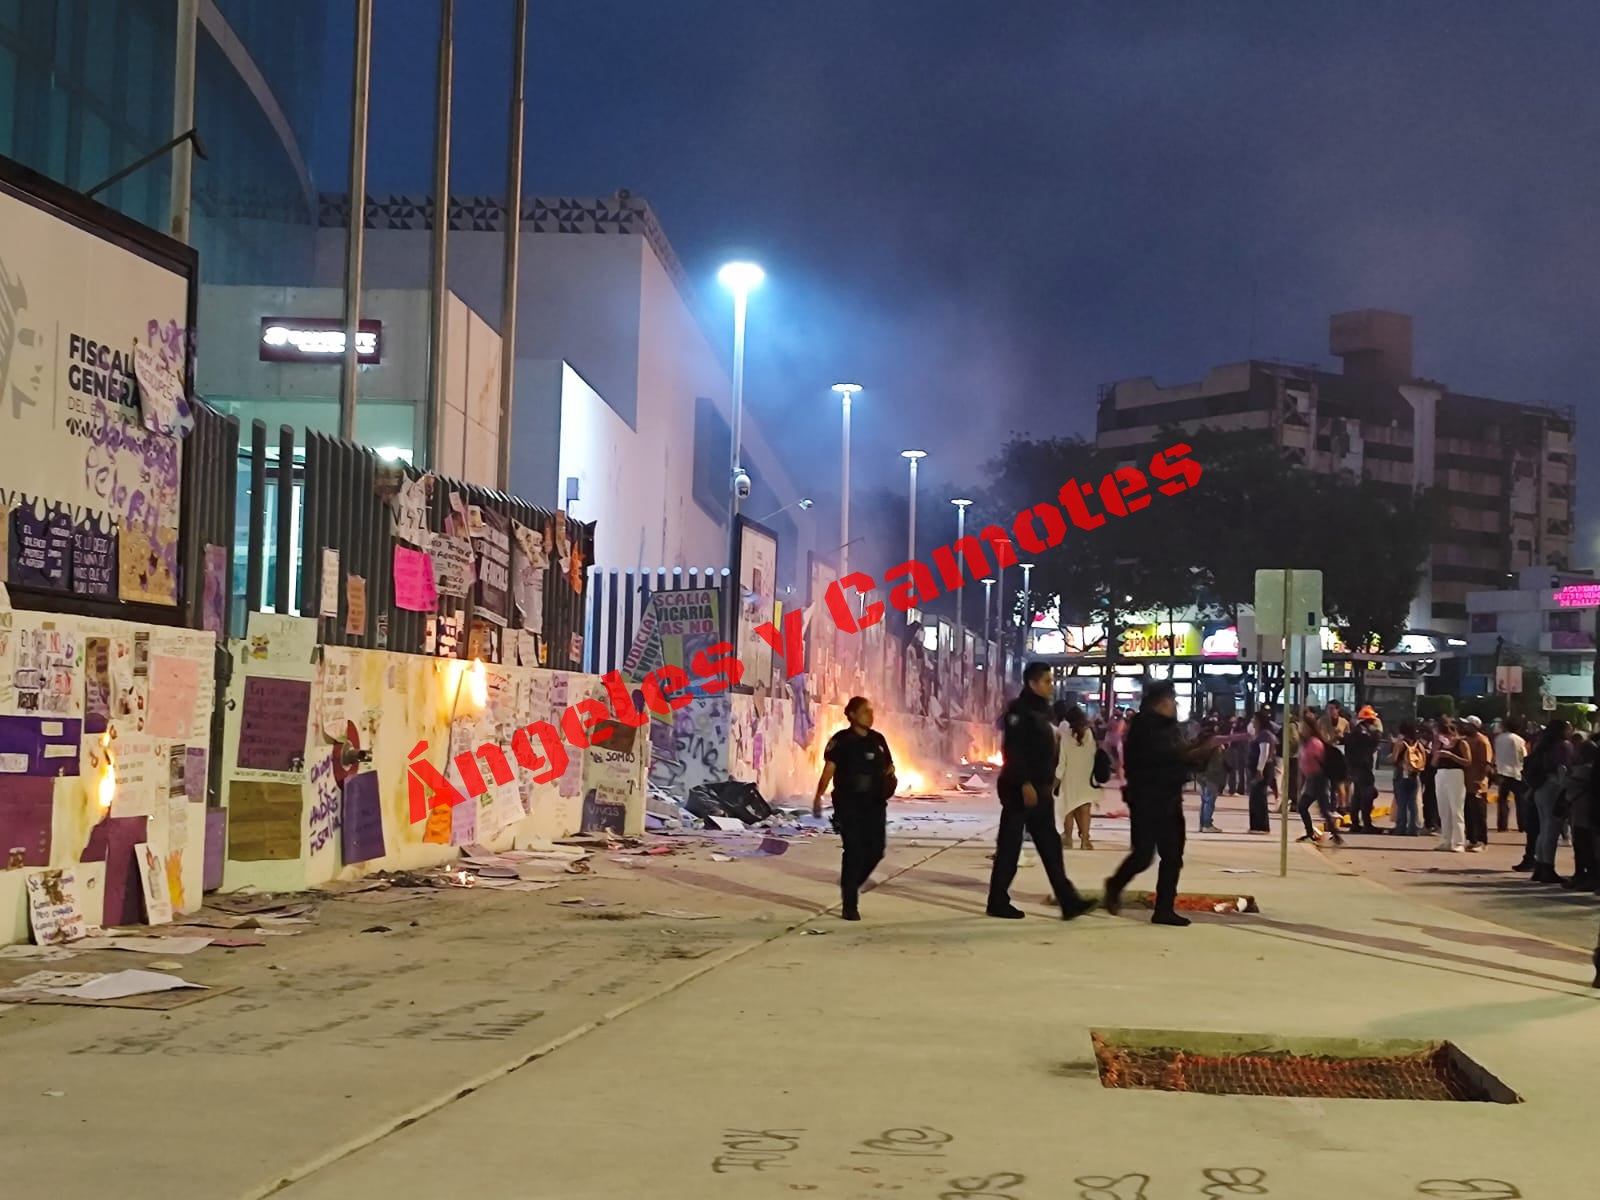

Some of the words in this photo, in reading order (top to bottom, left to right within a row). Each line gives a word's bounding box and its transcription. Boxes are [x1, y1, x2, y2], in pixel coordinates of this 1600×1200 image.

[68, 332, 137, 379] FISCAL
[67, 363, 141, 411] GENERA
[654, 591, 711, 606] SCALIA
[689, 619, 714, 634] NO
[1124, 636, 1147, 653] EXPO
[605, 751, 636, 763] SOMOS
